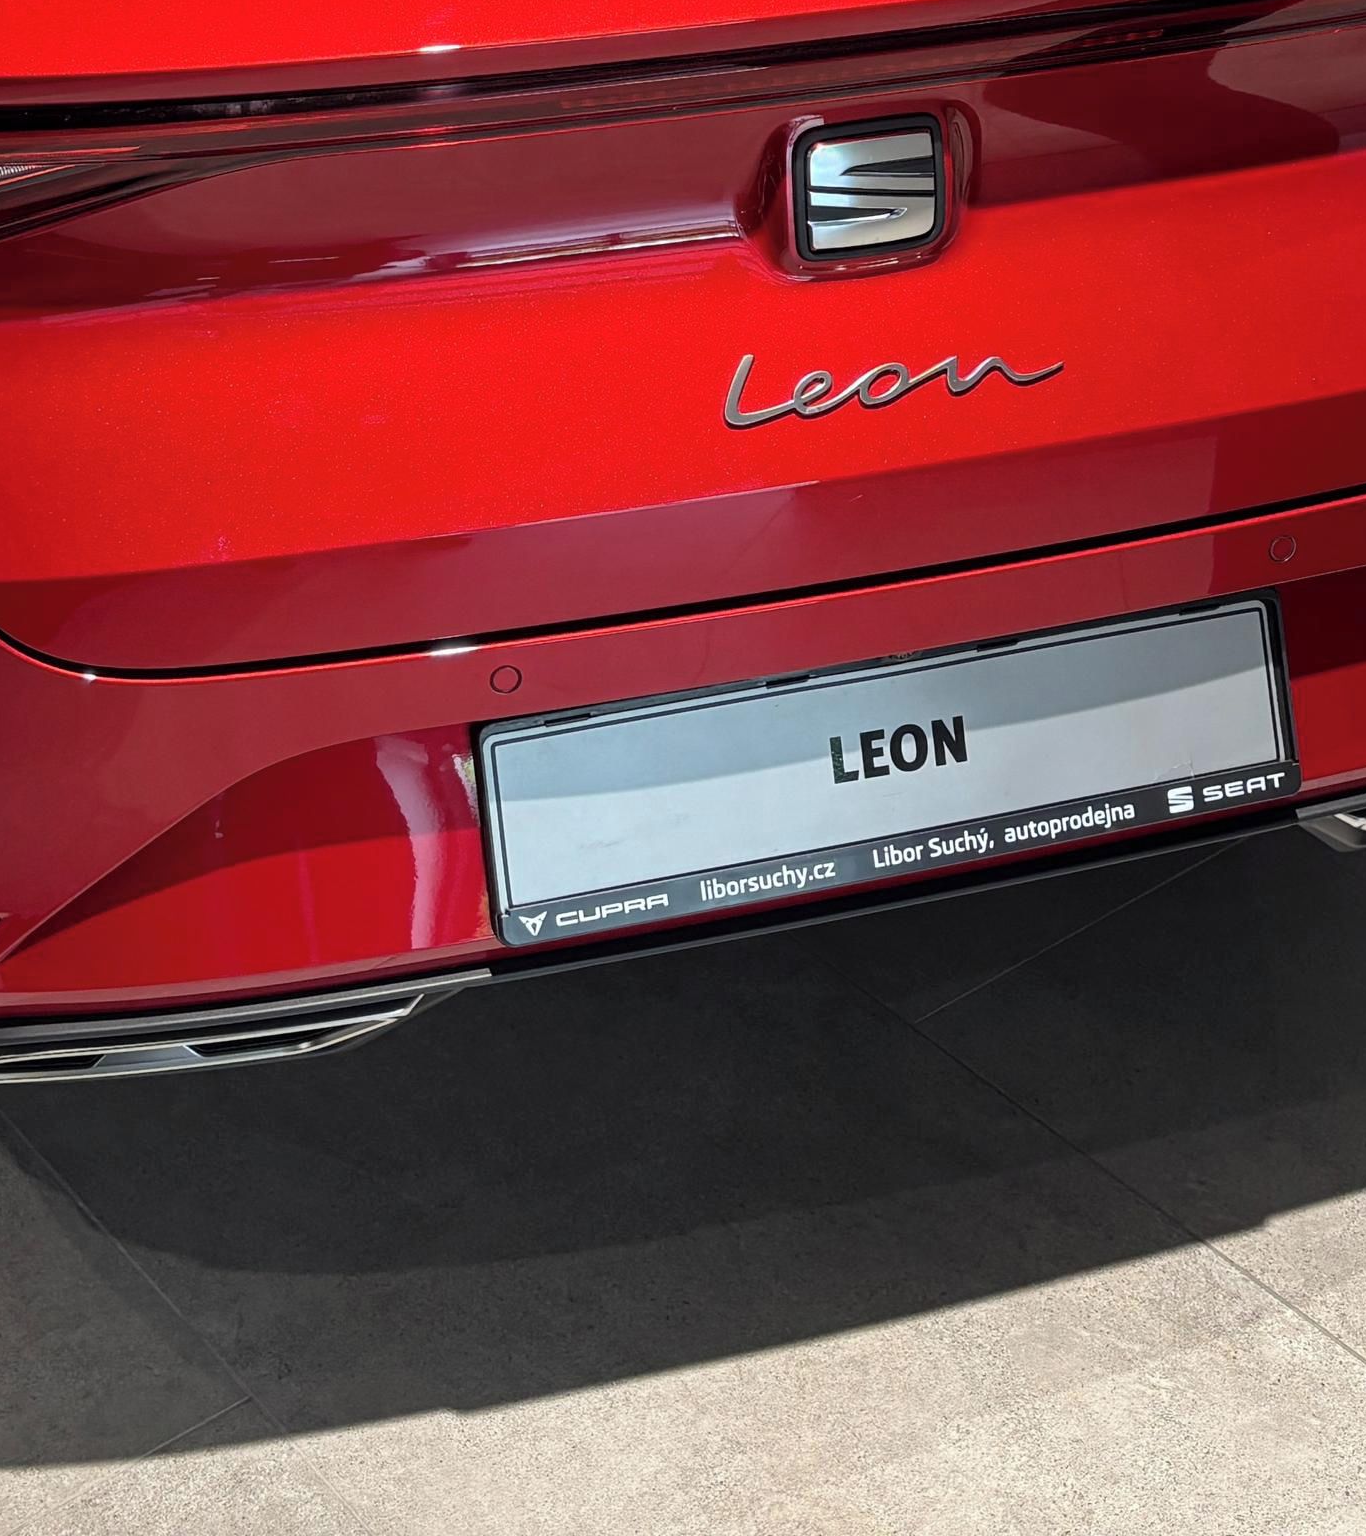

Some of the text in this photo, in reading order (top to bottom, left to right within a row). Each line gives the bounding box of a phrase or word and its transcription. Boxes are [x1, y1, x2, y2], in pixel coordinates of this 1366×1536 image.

[724, 354, 1064, 429] Leon
[830, 716, 967, 784] LEON
[1202, 772, 1285, 802] SEAT
[873, 803, 1135, 868] Libor Suchý, autoprodejna
[700, 862, 835, 901] liborsuchy.cz
[556, 893, 669, 927] CUPRA
